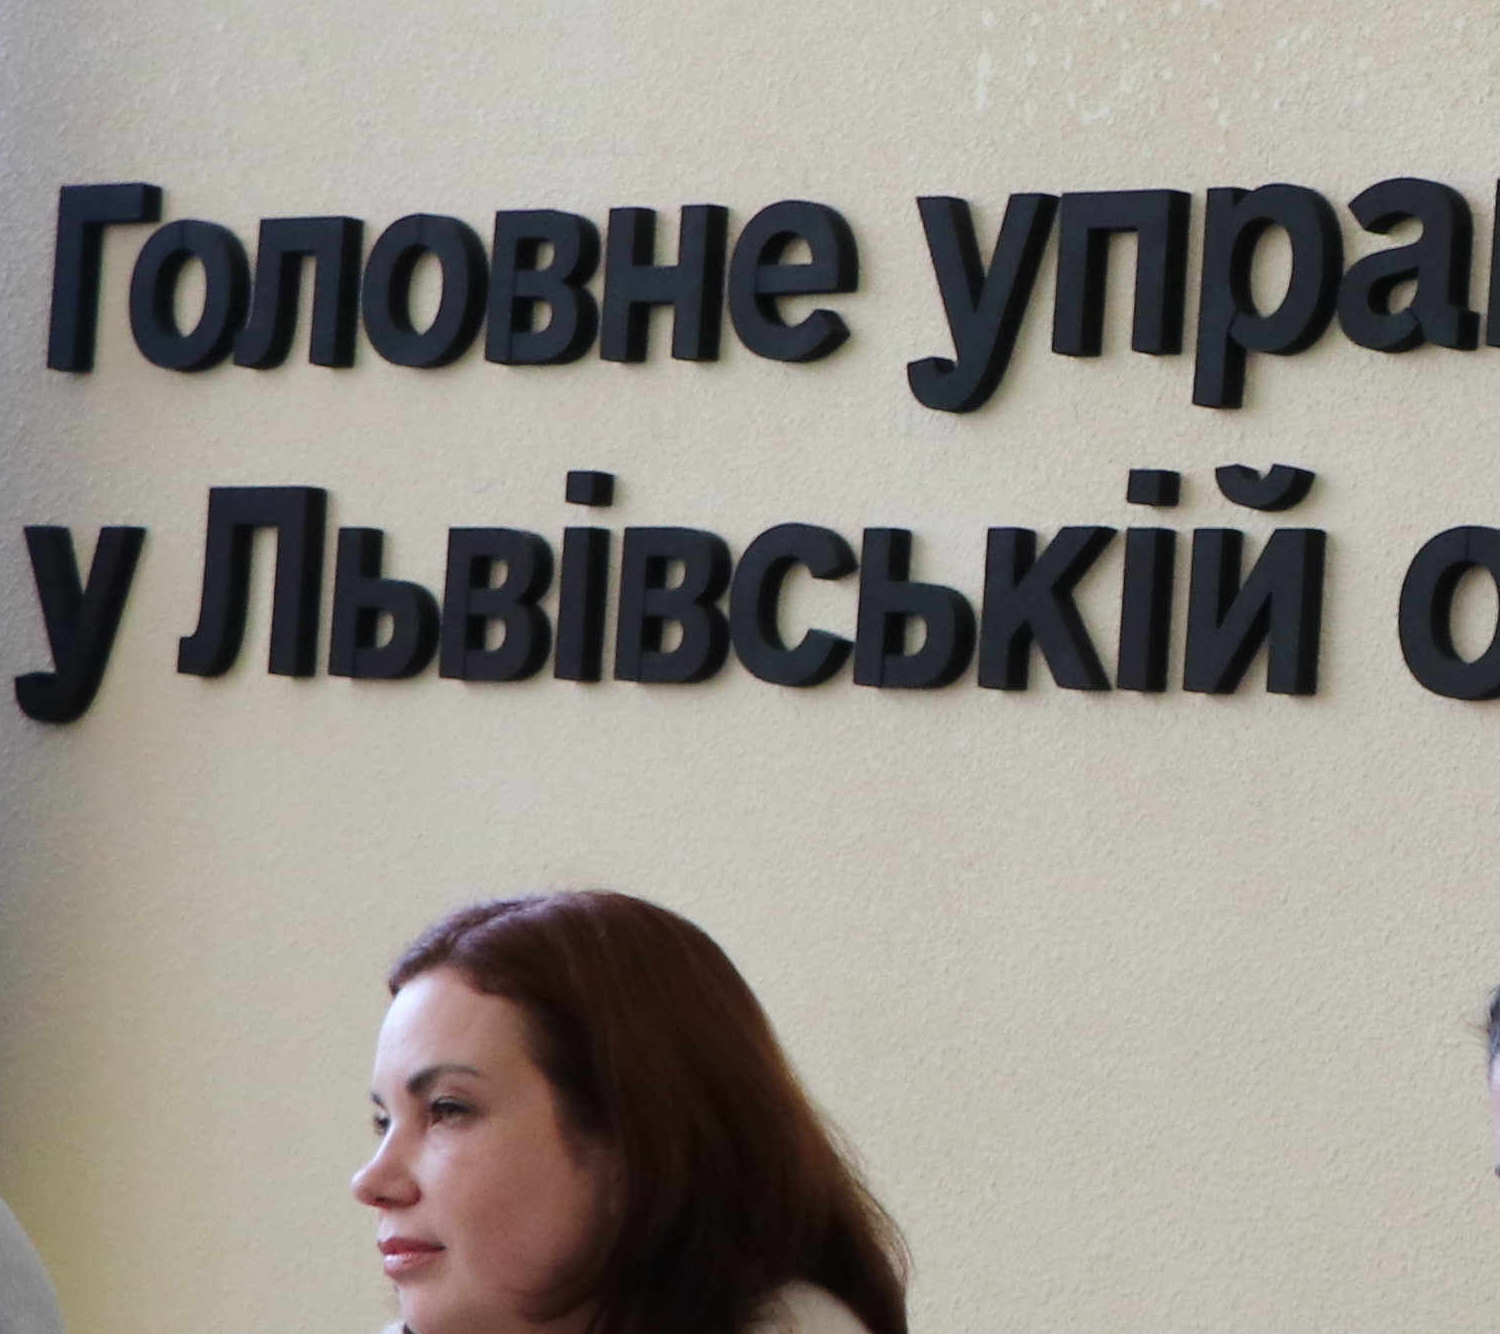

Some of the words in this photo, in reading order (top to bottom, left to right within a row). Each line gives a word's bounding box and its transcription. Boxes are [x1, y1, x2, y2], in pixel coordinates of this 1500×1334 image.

[44, 182, 862, 379] Головне
[12, 524, 150, 732] у
[175, 462, 1329, 699] Львівській
